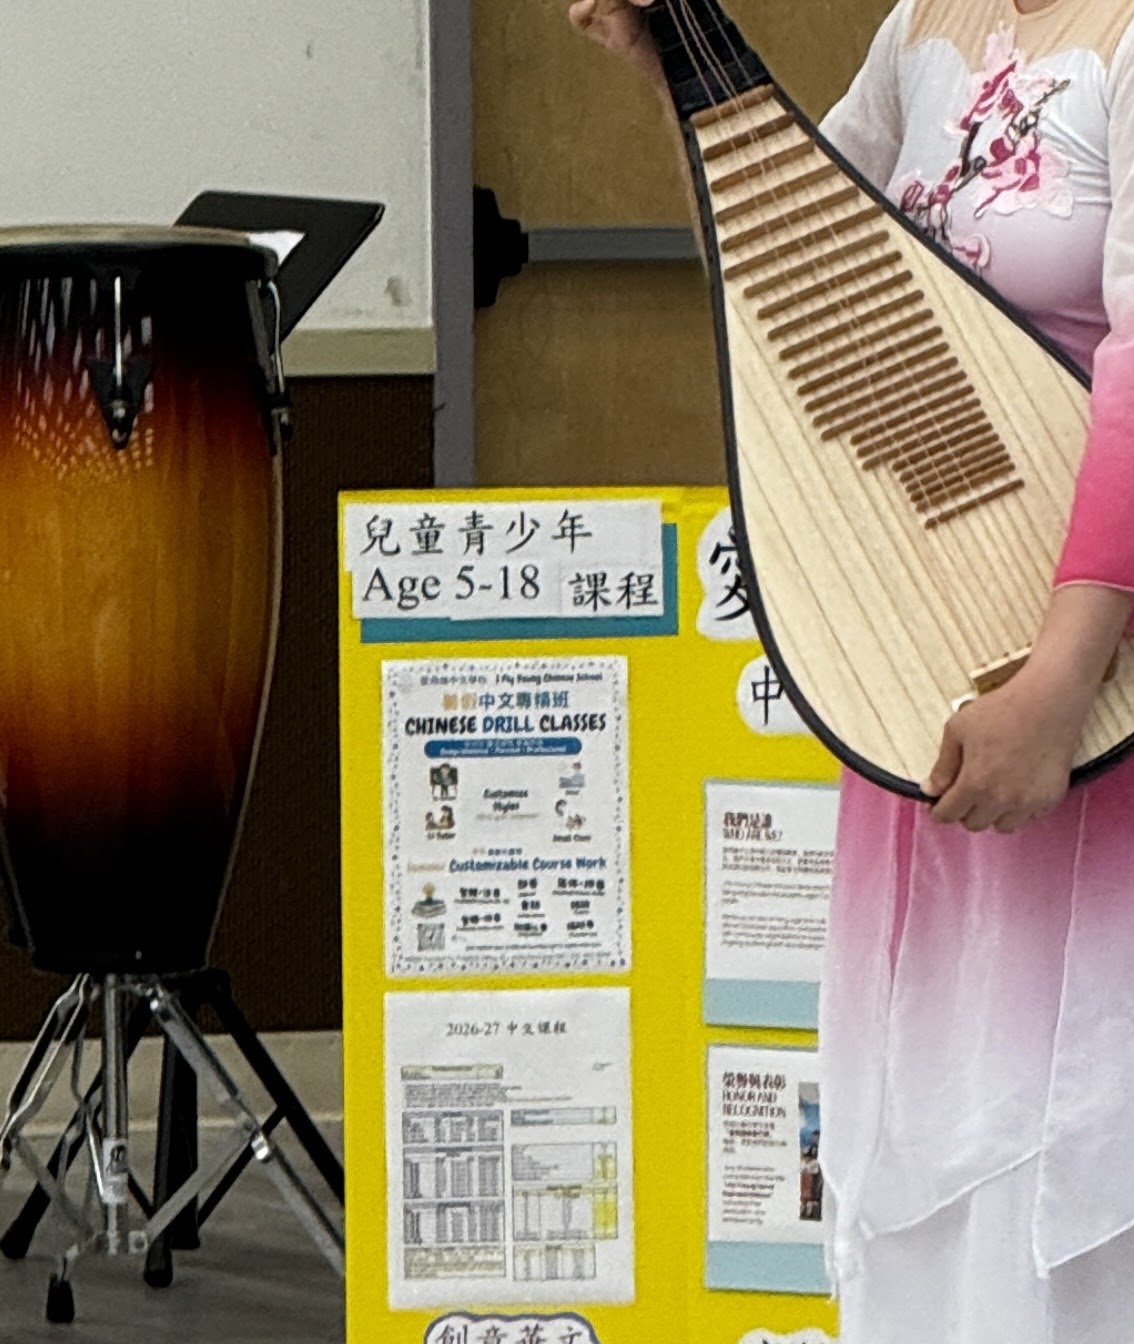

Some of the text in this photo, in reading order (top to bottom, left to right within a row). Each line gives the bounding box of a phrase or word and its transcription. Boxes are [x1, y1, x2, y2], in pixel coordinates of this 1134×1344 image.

[359, 508, 593, 557] 兒童青少年
[362, 564, 660, 613] Age 5-18 課程
[751, 665, 784, 726] 中
[405, 713, 607, 736] CHINESE DRILL CLASSES
[450, 858, 529, 873] Customizable
[533, 857, 572, 870] Course
[576, 856, 607, 869] Work
[446, 1021, 500, 1037] 2026-27
